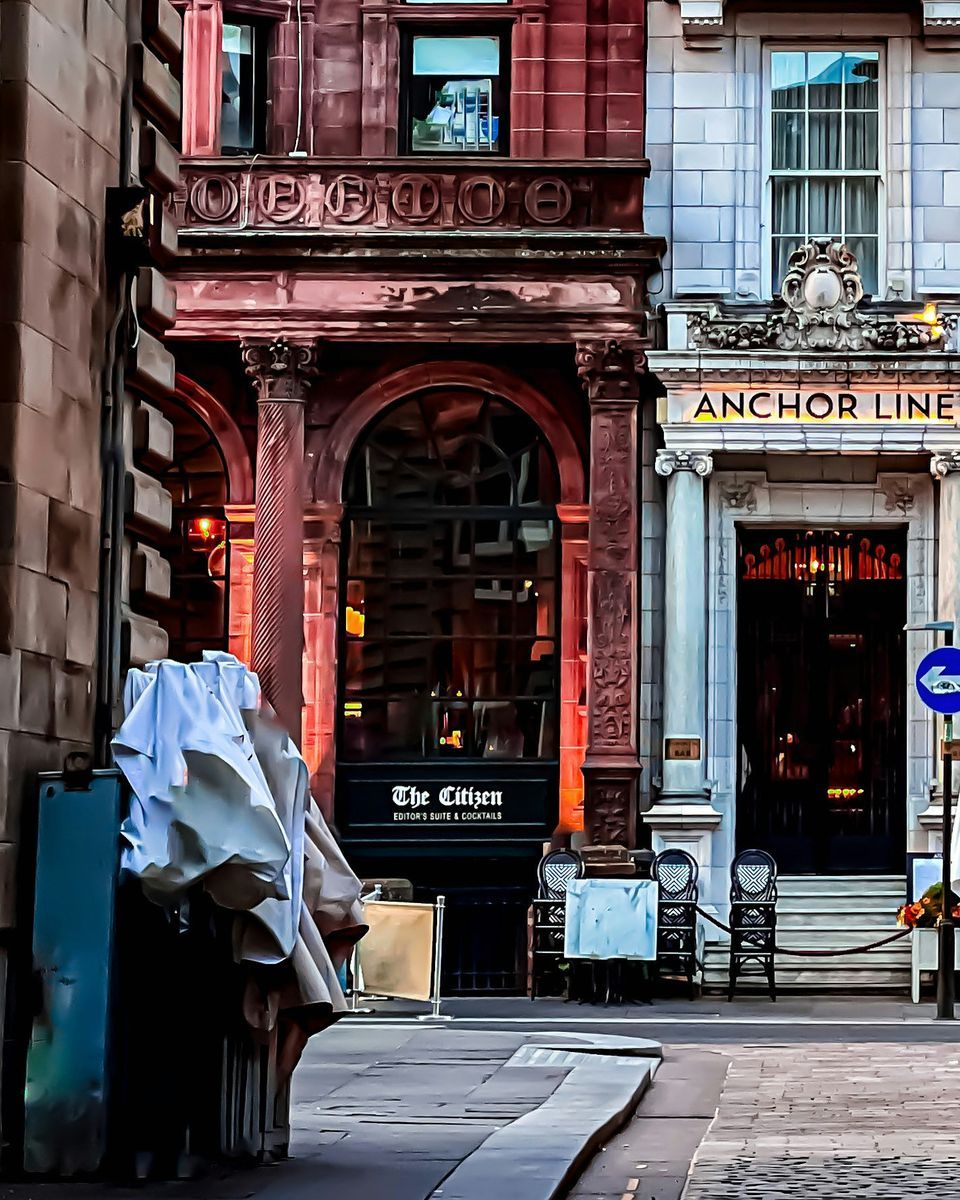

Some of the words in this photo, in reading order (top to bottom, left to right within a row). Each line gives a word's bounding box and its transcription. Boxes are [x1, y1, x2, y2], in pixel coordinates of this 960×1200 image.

[694, 392, 858, 419] ANCHOR
[875, 393, 955, 419] LINE
[392, 785, 430, 809] The
[439, 785, 503, 810] Citizen
[393, 812, 428, 821] EDITOR'S
[430, 812, 452, 821] SUITE
[454, 812, 459, 820] &
[461, 811, 502, 820] COCKTAILS
